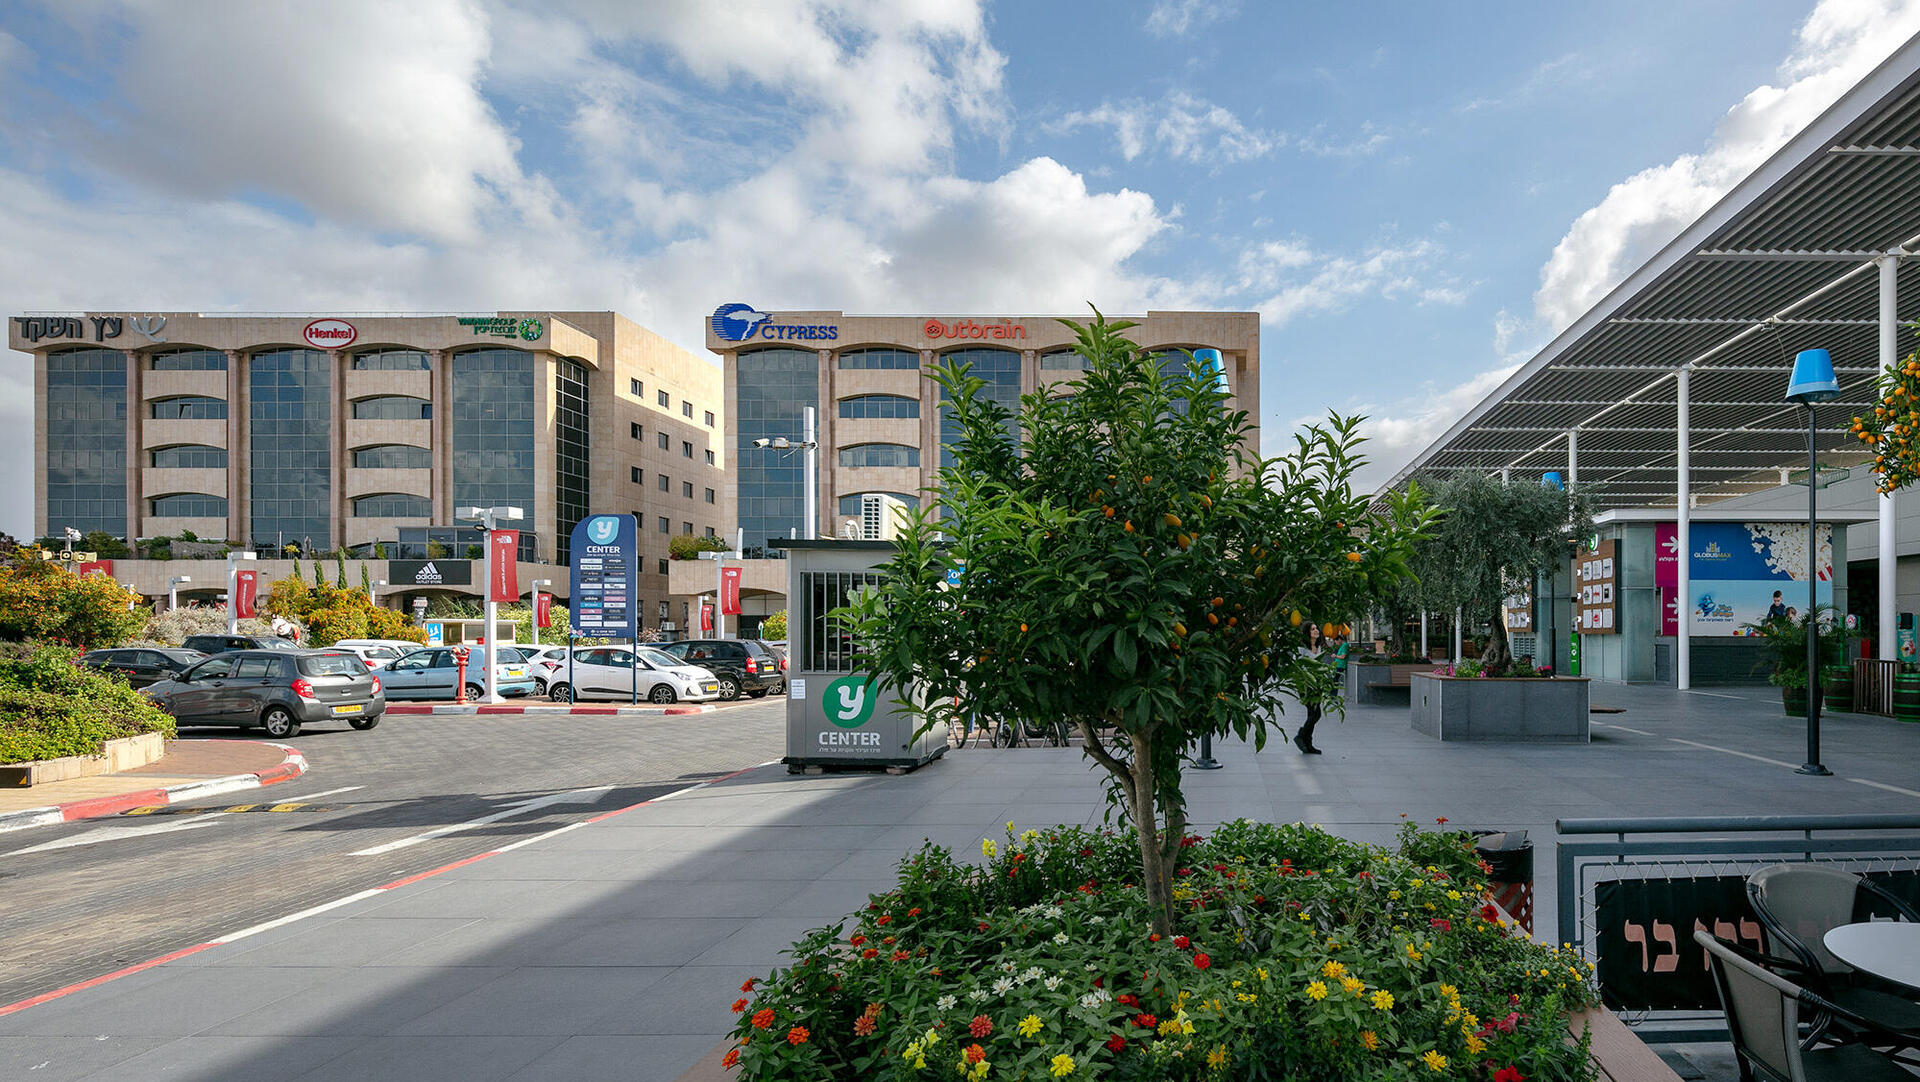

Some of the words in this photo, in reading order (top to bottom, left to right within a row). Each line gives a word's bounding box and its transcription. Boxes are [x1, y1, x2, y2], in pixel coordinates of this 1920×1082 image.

[14, 316, 83, 343] השקד
[90, 316, 123, 342] עץ
[308, 327, 352, 339] Henkel
[761, 325, 839, 341] CYPRESS
[924, 318, 1026, 340] Outbrain
[586, 545, 621, 554] CENTER
[415, 572, 443, 580] adidas
[818, 731, 881, 746] CENTER
[1624, 917, 1680, 973] בר
